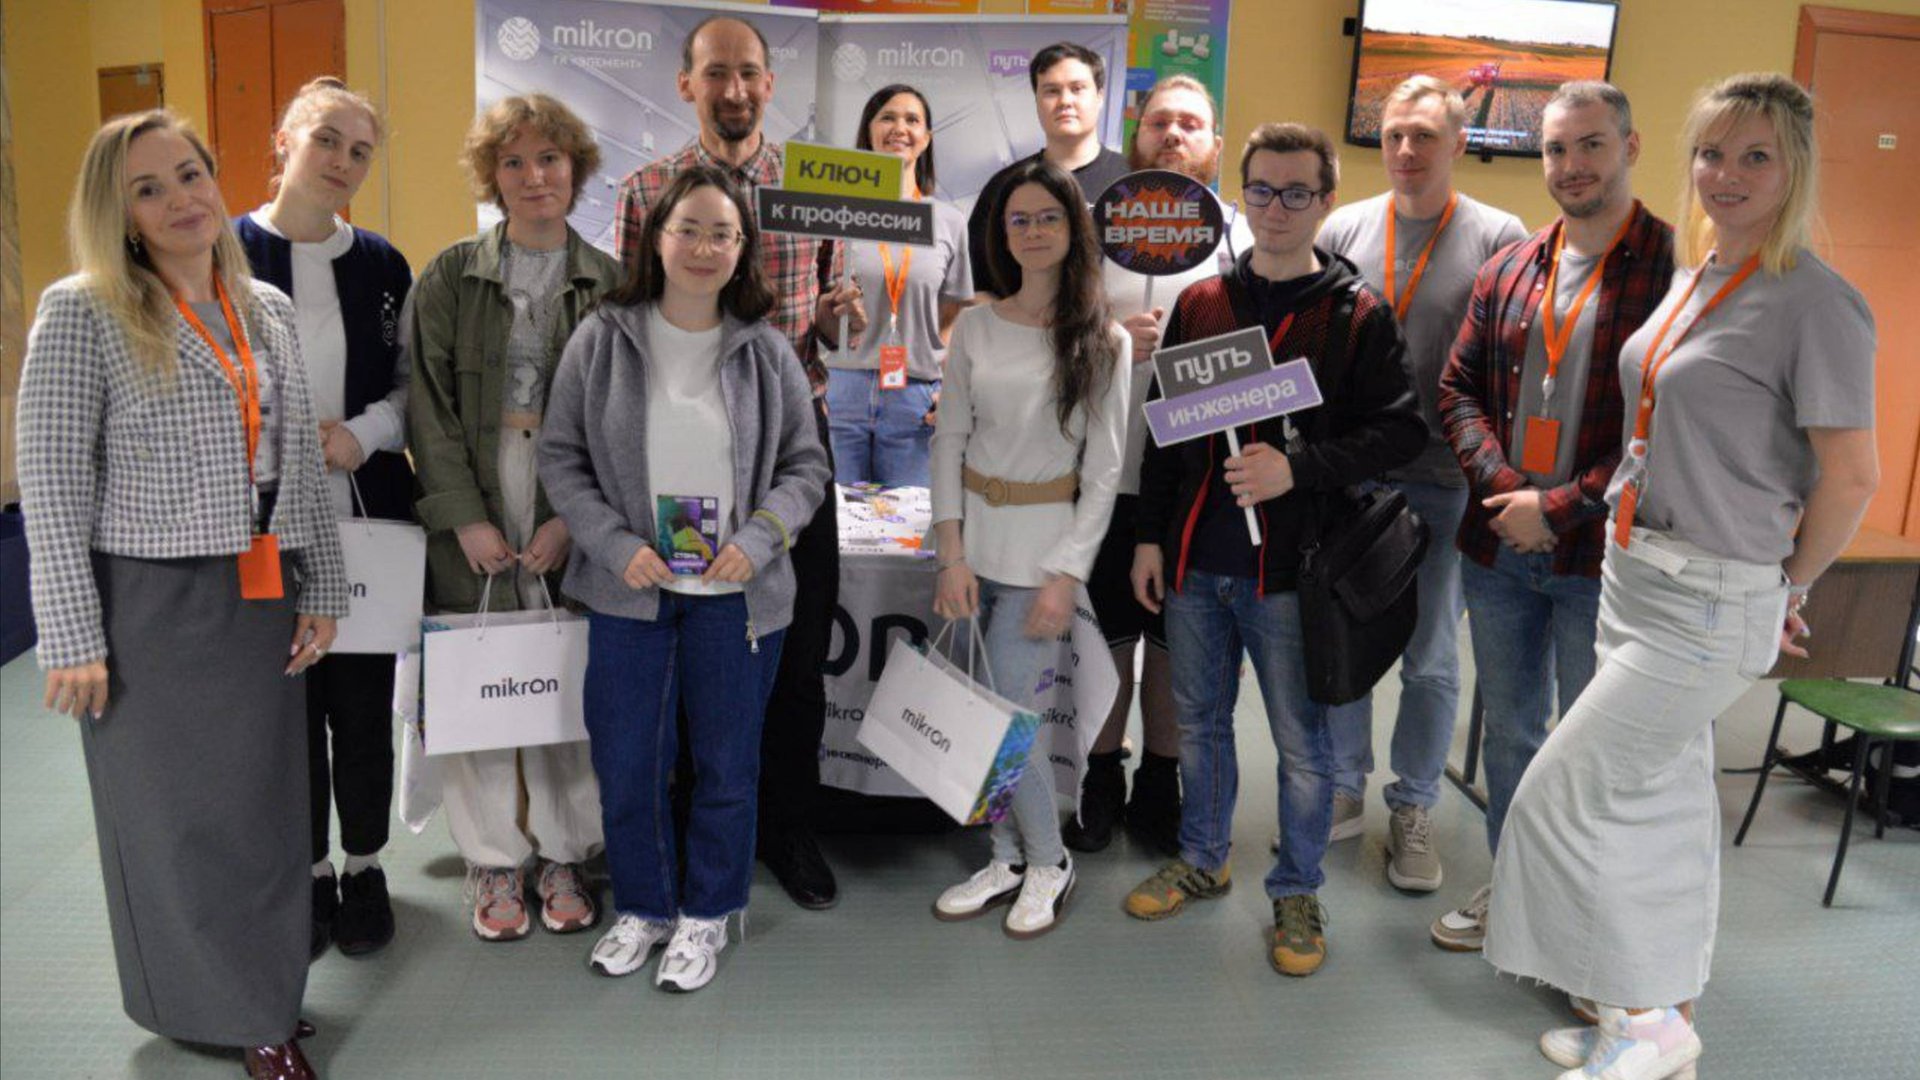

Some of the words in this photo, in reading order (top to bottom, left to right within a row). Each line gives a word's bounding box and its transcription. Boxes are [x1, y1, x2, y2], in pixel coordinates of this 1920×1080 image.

[771, 203, 786, 219] к
[791, 205, 923, 231] профессии
[1104, 201, 1200, 219] НАШЕ
[1104, 226, 1215, 243] ВРЕМЯ
[1168, 378, 1299, 429] инженера
[481, 677, 559, 699] mikron
[901, 708, 952, 754] mikron
